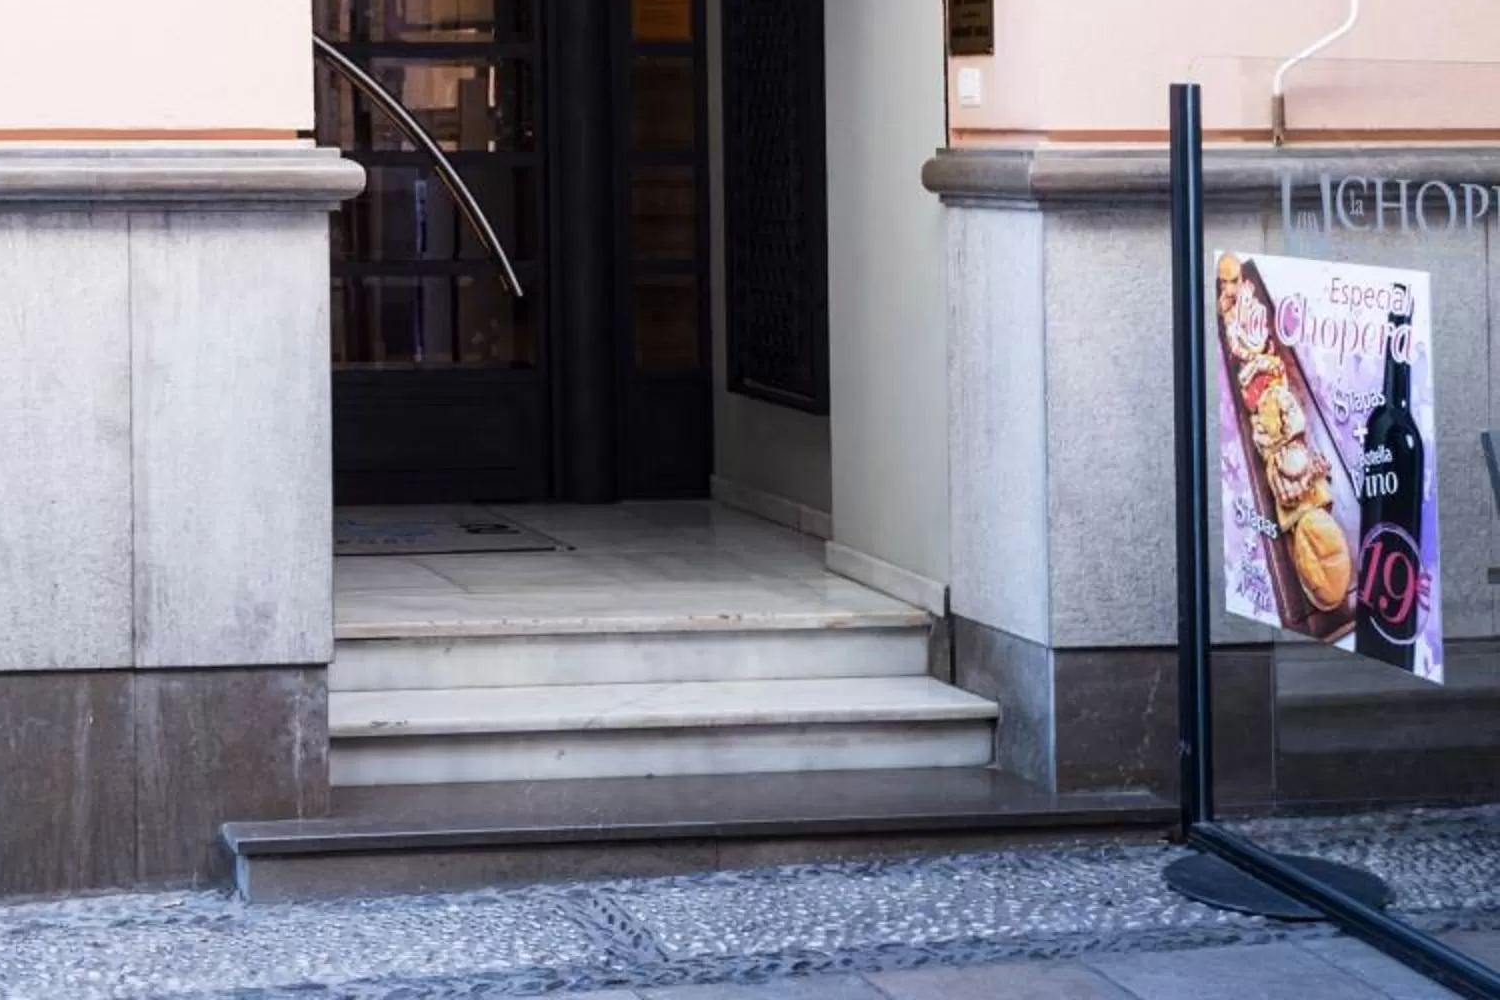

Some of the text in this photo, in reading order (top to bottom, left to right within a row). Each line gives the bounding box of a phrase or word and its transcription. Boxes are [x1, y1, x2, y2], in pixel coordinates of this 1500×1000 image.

[1329, 277, 1413, 316] Especial
[1275, 293, 1414, 366] Chopera
[1351, 466, 1399, 498] Vino
